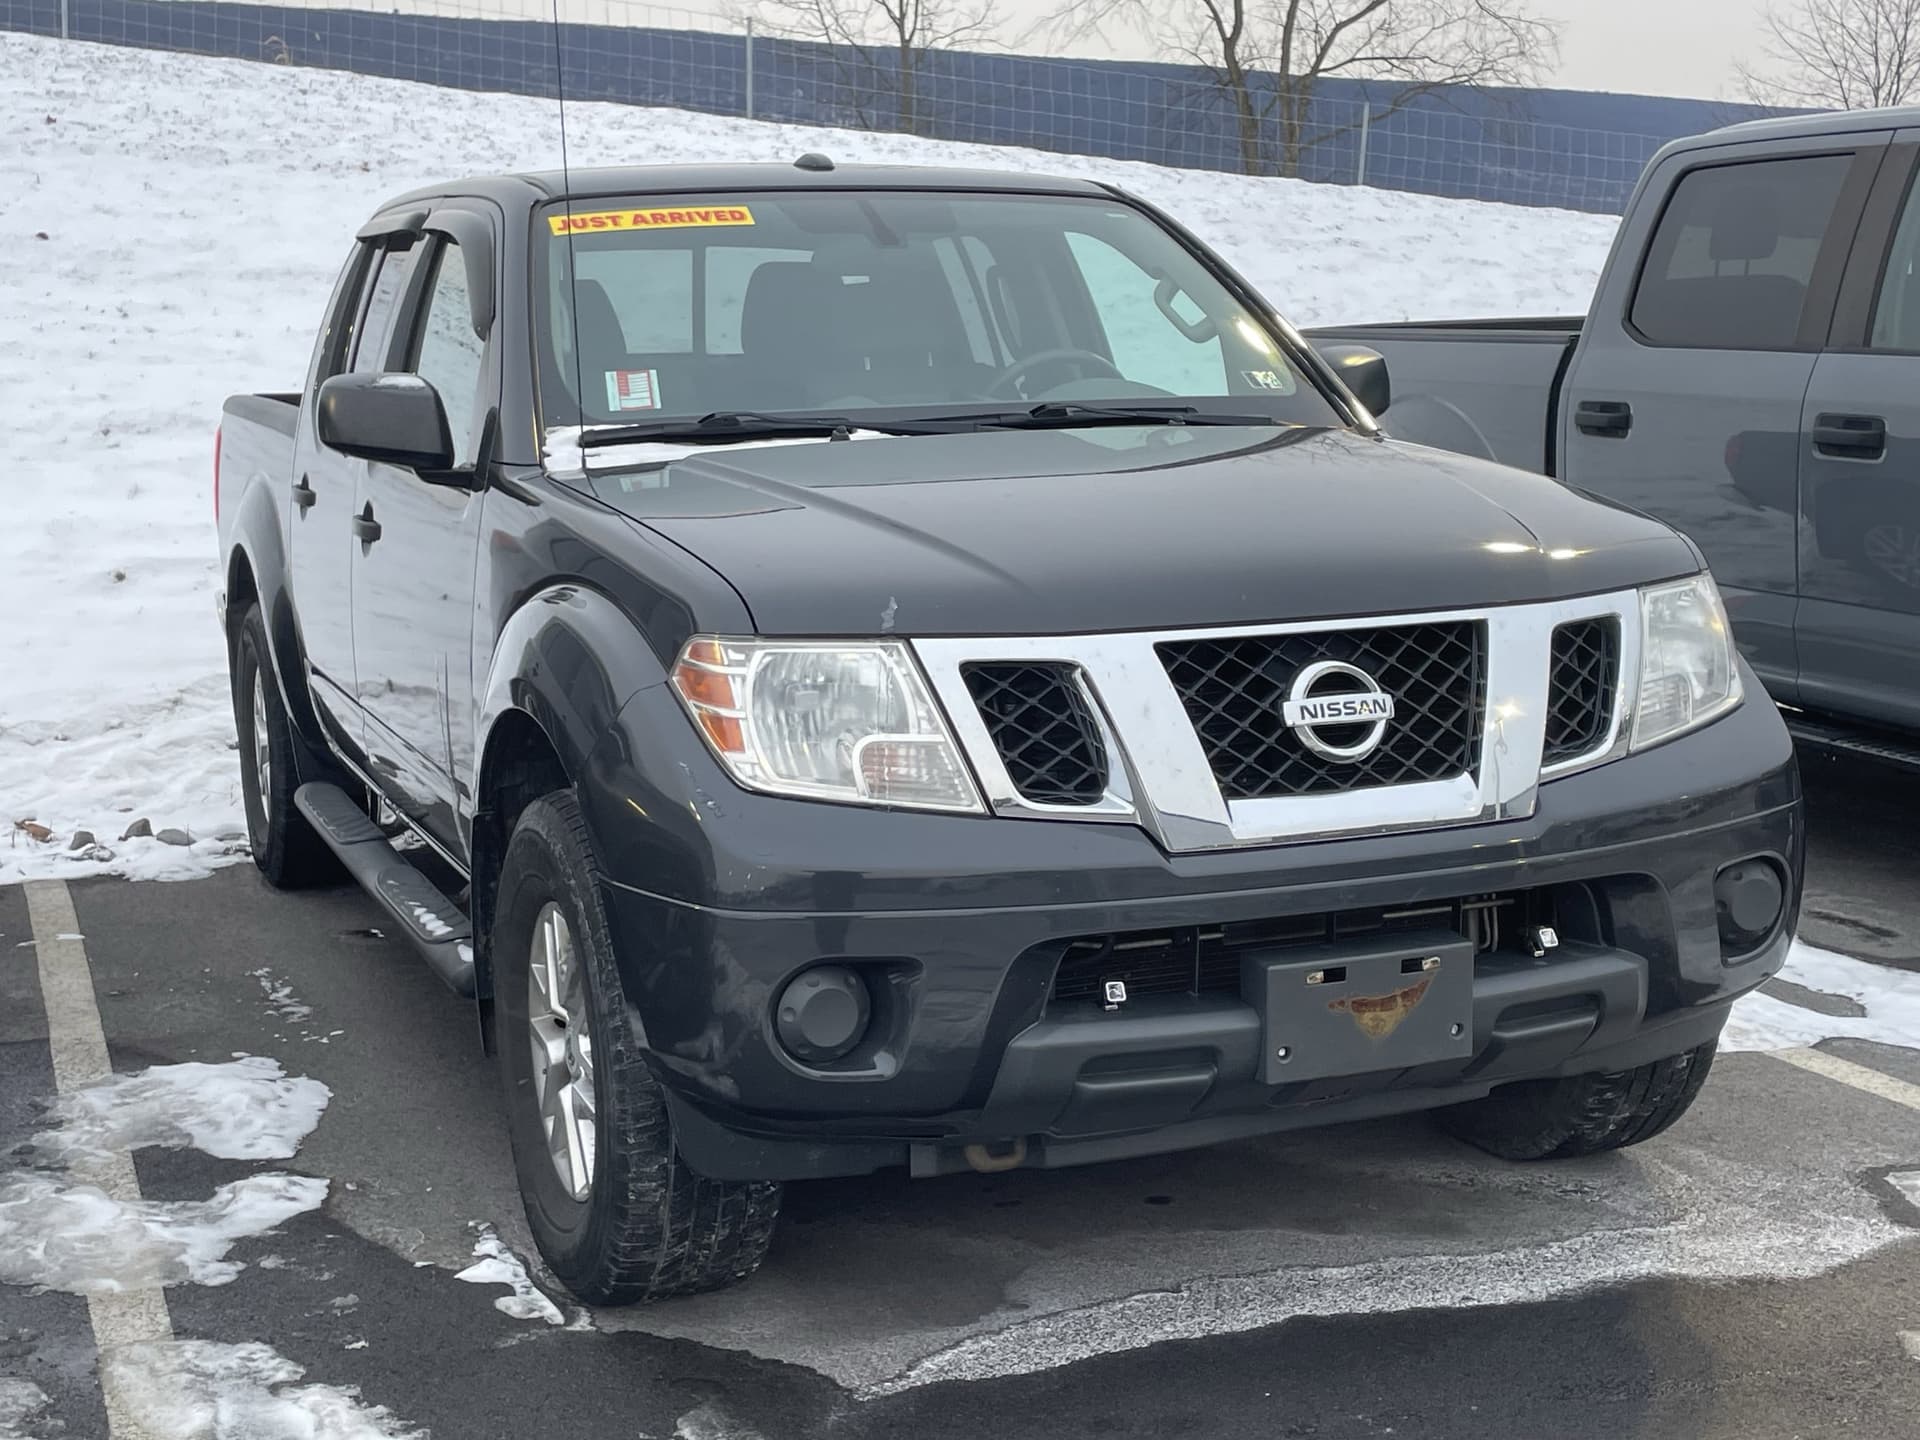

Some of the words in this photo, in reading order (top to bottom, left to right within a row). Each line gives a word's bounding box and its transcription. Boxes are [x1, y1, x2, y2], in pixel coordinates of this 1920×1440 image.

[558, 216, 622, 231] JUST
[632, 211, 747, 226] ARRIVED
[1300, 699, 1387, 720] NISSAN
